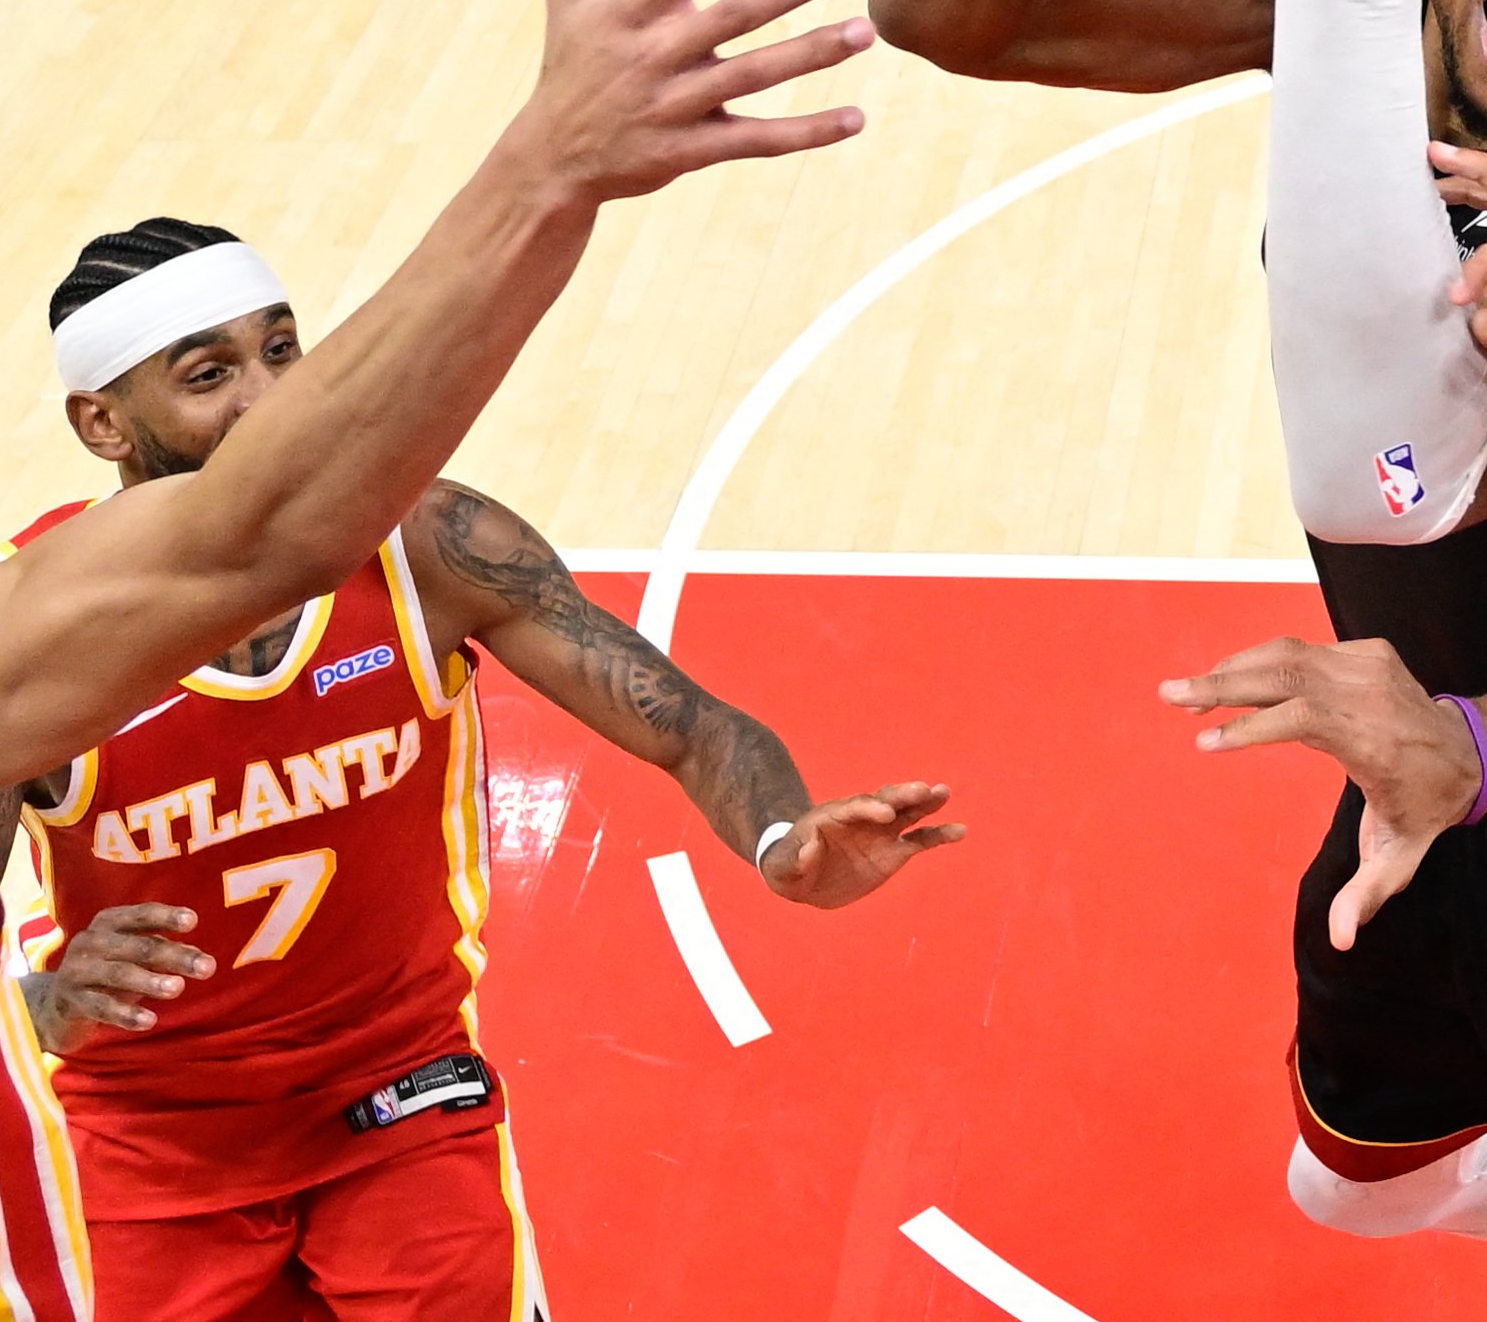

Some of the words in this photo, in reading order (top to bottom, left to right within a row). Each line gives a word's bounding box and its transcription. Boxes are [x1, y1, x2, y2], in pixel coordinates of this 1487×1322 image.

[314, 646, 394, 695] paze
[92, 718, 421, 864] ATLANTA
[222, 848, 337, 970] 7
